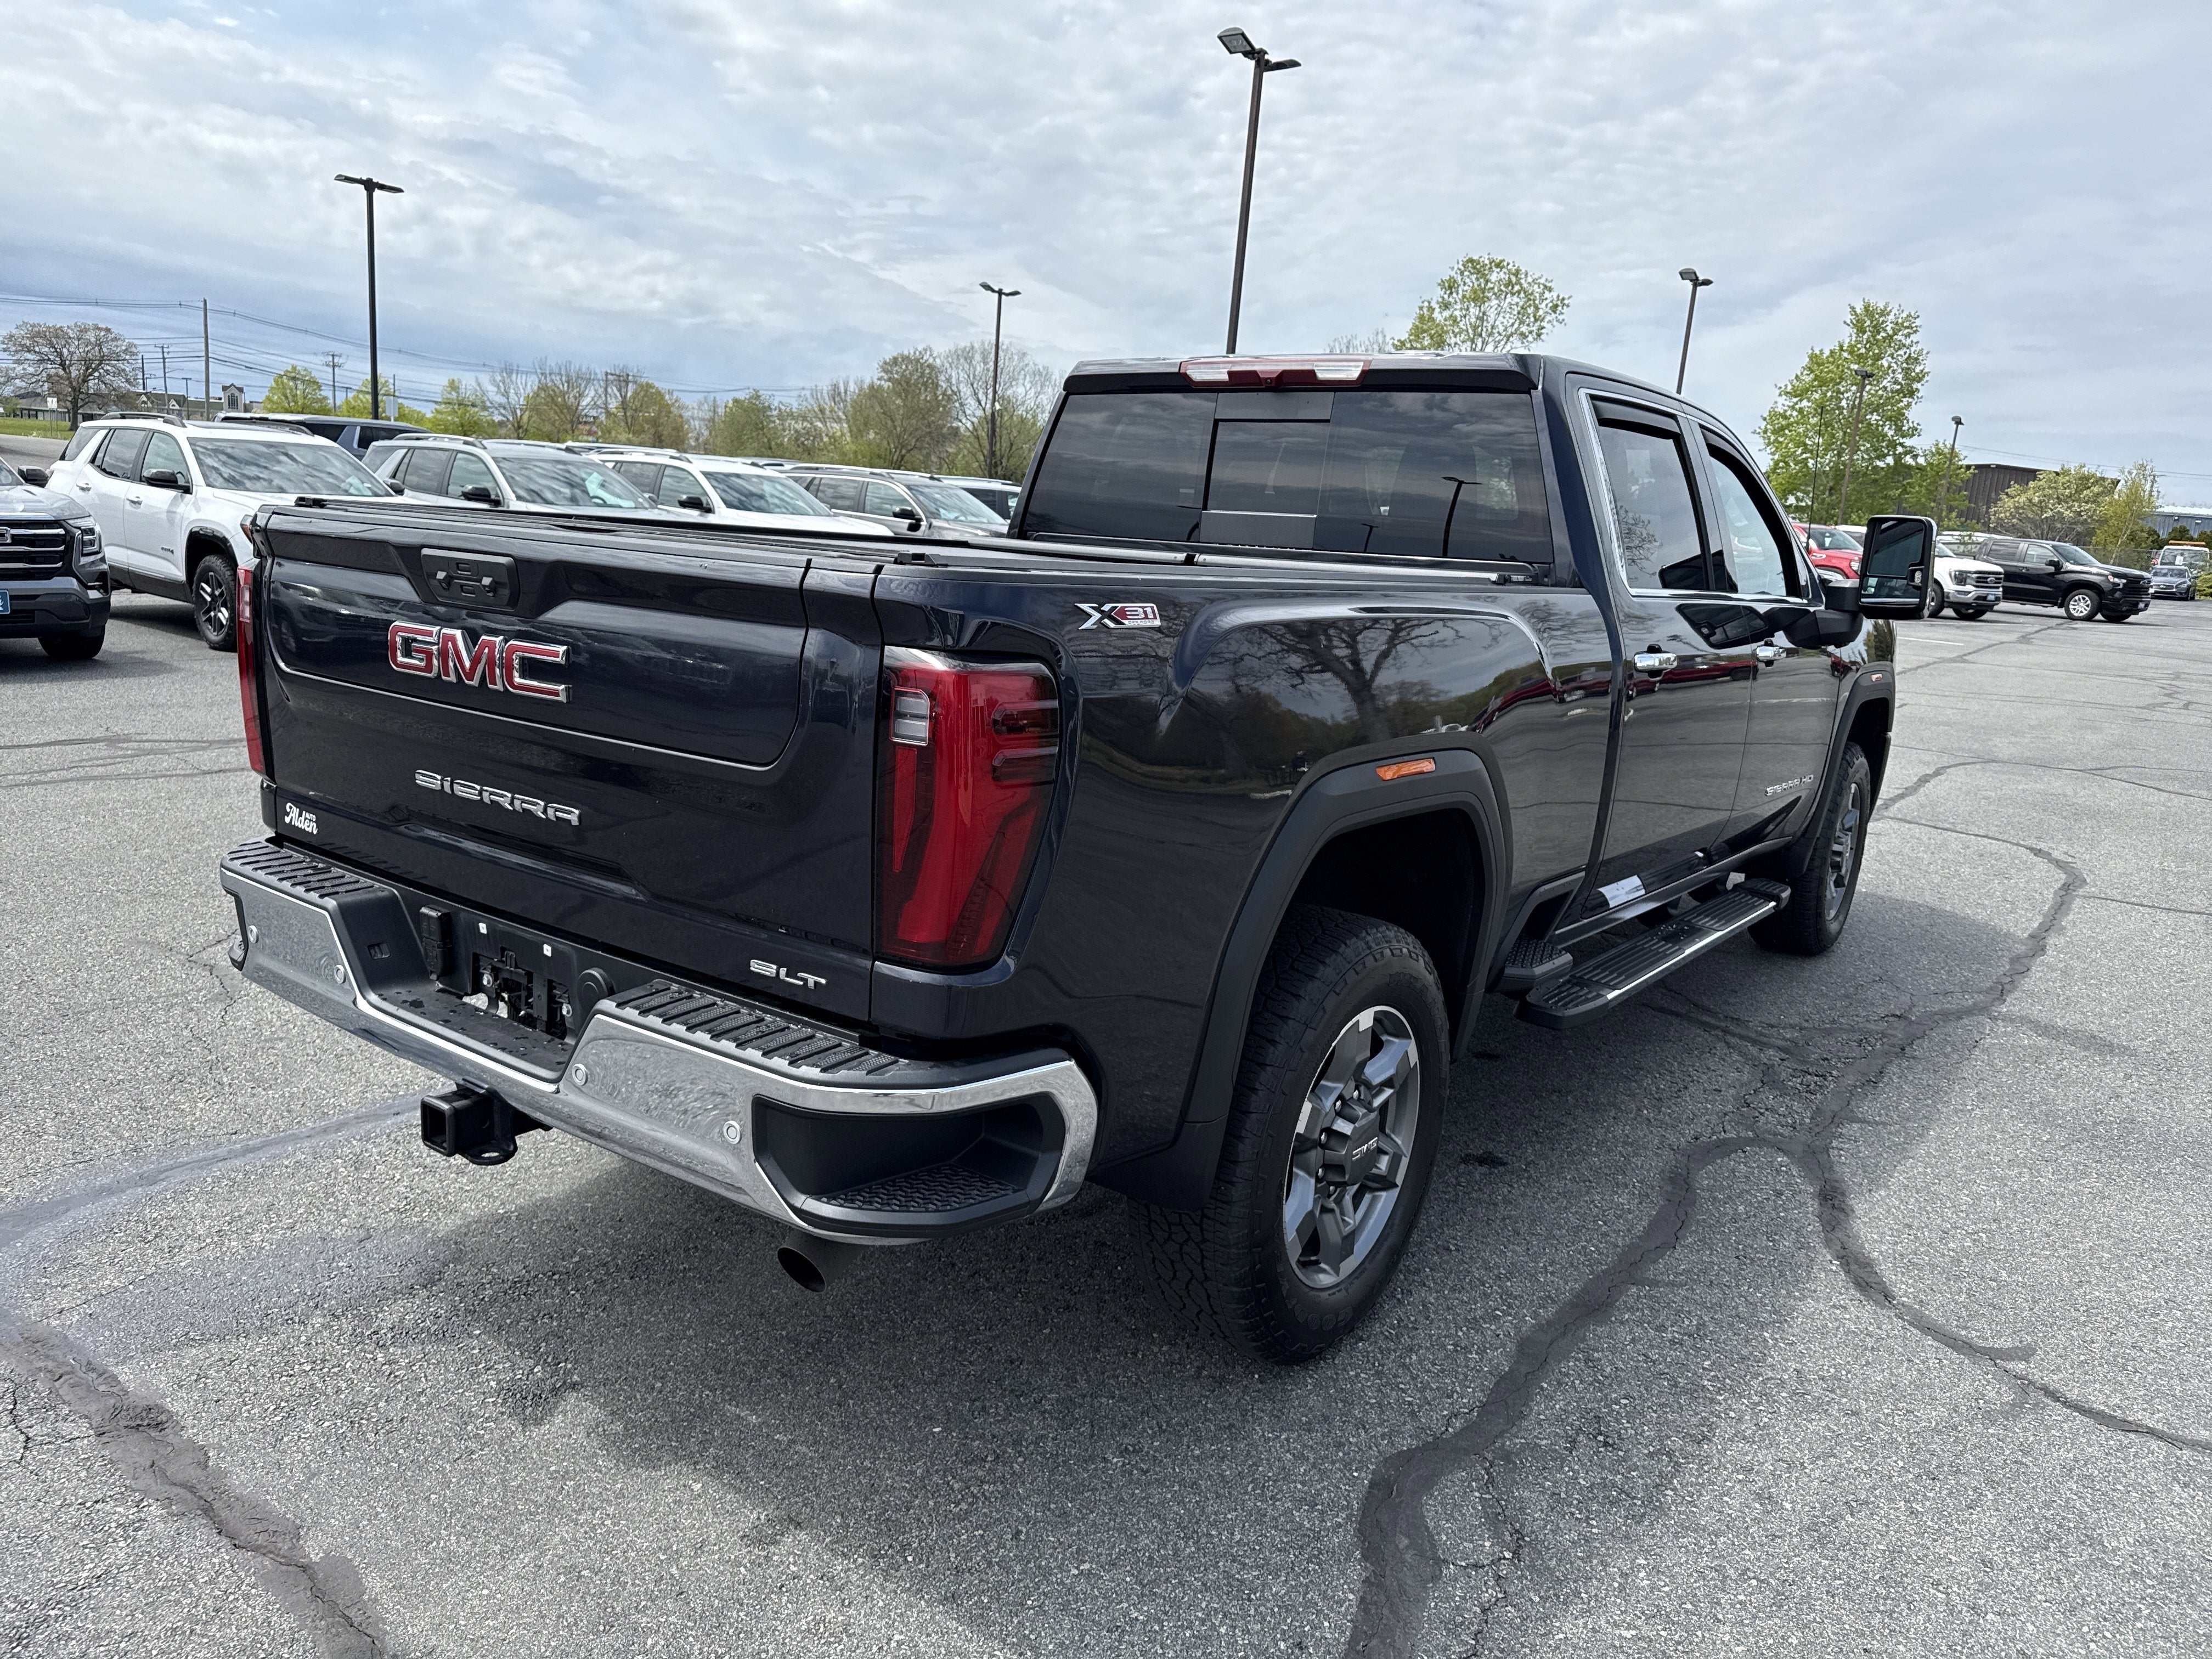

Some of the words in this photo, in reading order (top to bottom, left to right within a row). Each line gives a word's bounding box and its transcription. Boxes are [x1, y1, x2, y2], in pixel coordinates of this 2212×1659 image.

[1074, 603, 1161, 630] X31
[388, 620, 569, 704] GMC
[415, 770, 580, 825] SIERRA
[1765, 779, 1800, 797] SIERRA
[1800, 774, 1814, 786] HD
[285, 803, 318, 834] Alden
[306, 812, 316, 821] AUTO
[750, 960, 826, 989] SLT
[1352, 1137, 1378, 1161] GMC
